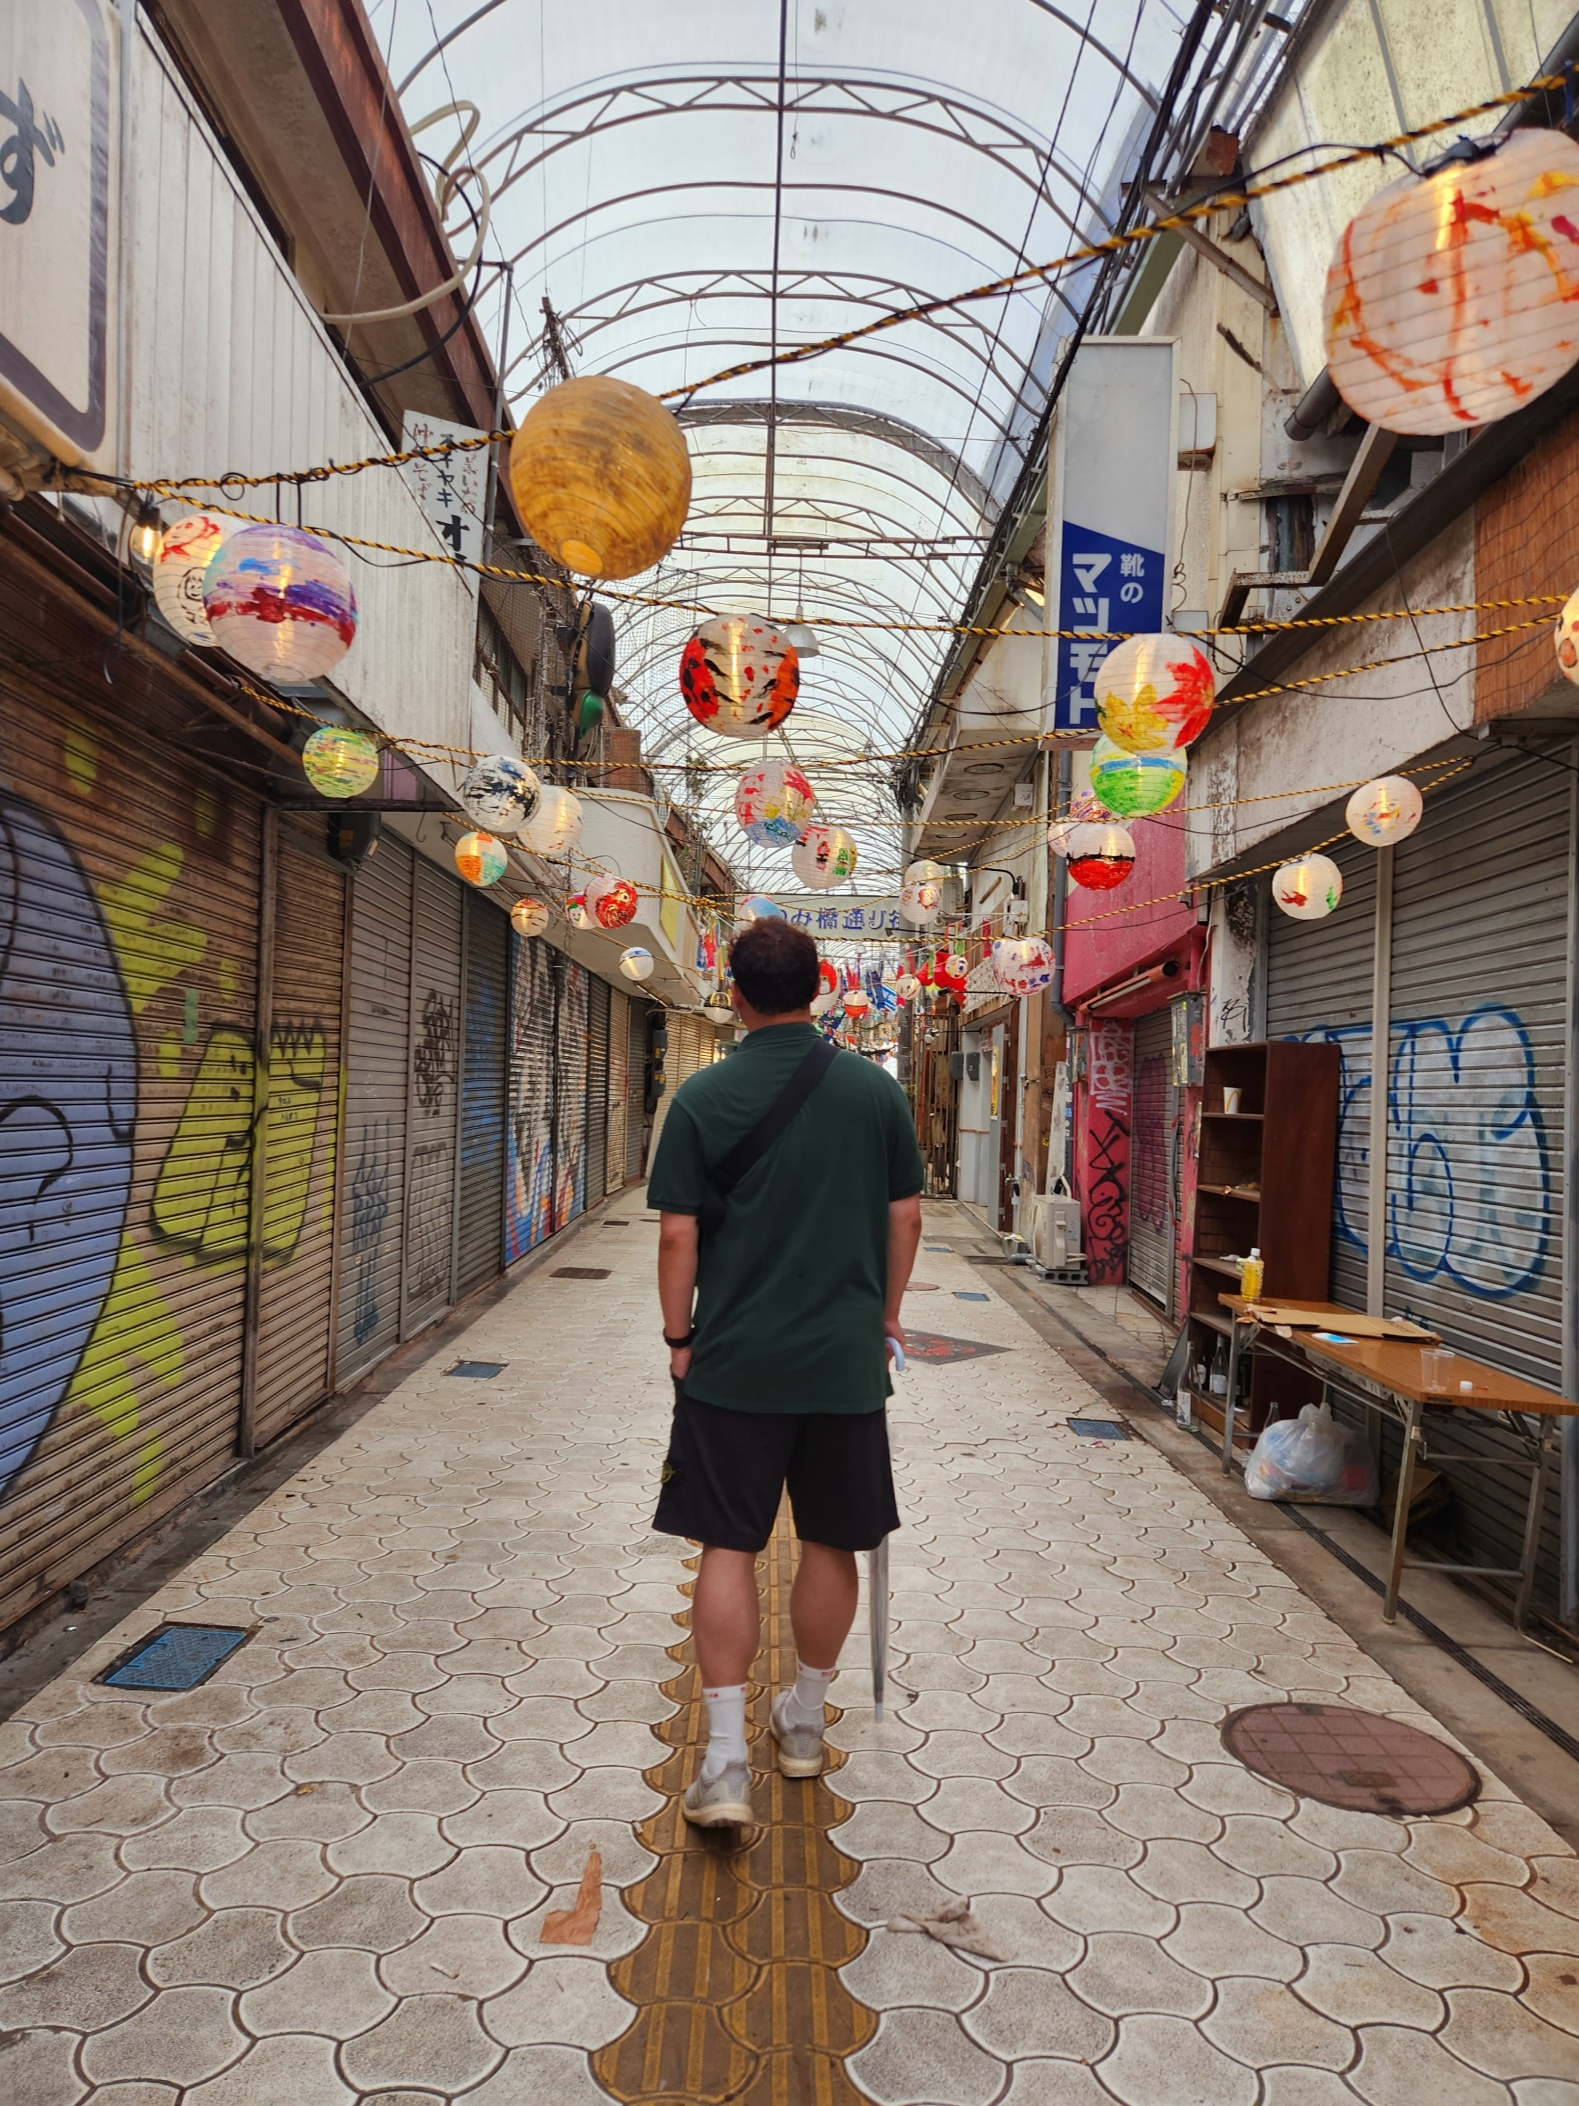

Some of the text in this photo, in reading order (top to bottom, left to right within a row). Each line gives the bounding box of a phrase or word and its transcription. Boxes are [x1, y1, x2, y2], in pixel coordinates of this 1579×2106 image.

[412, 423, 434, 500] 沖そば
[1119, 552, 1145, 604] 靴の
[1069, 553, 1112, 724] マツモト
